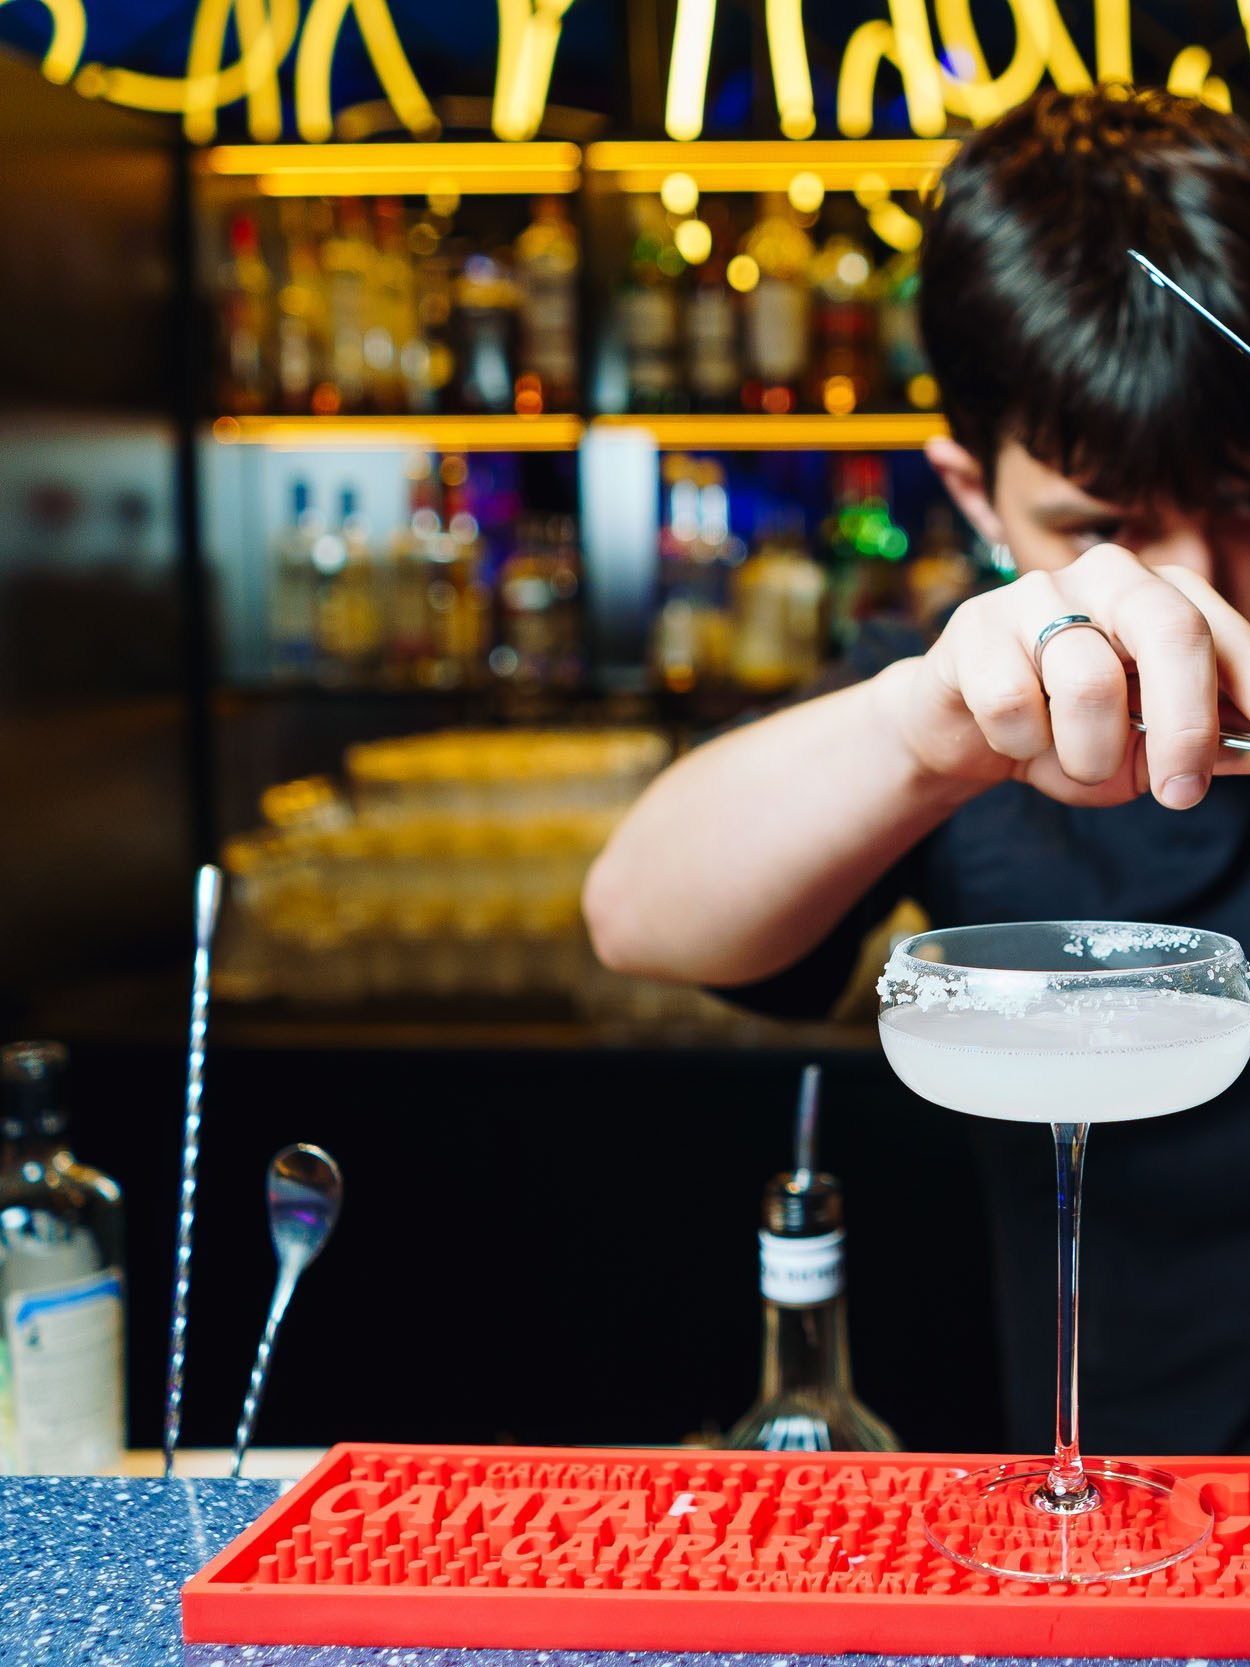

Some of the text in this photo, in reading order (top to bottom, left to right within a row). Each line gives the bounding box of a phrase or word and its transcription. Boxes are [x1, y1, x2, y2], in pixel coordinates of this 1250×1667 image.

[485, 1462, 649, 1483] CAMPARI
[310, 1480, 769, 1530] CAMPARI
[501, 1530, 841, 1563] CAMPARI
[738, 1570, 921, 1589] CAMPARI
